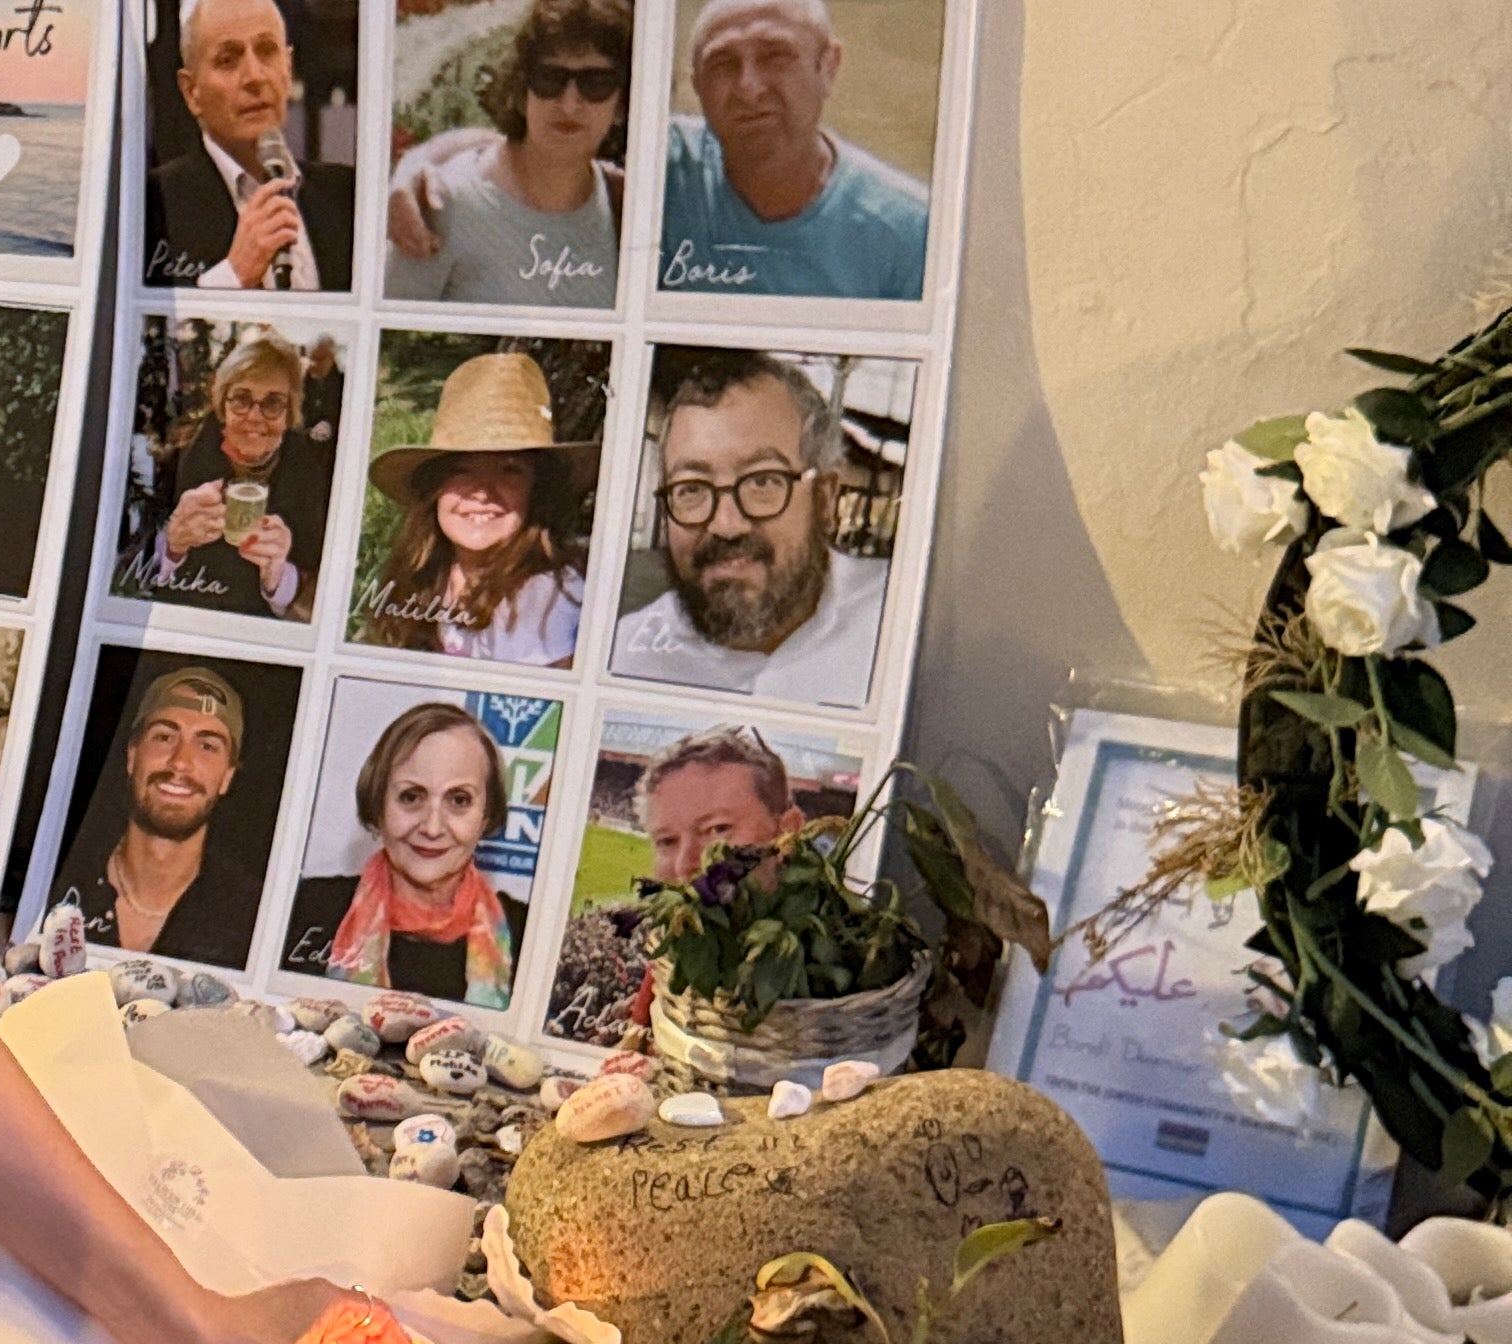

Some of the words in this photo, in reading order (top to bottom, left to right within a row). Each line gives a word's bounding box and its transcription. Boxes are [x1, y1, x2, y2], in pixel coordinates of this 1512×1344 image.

[518, 234, 606, 282] Sofia
[663, 239, 757, 286] Boris
[119, 550, 231, 598] Marika
[349, 582, 479, 628] Matilda
[546, 984, 653, 1042] Adam
